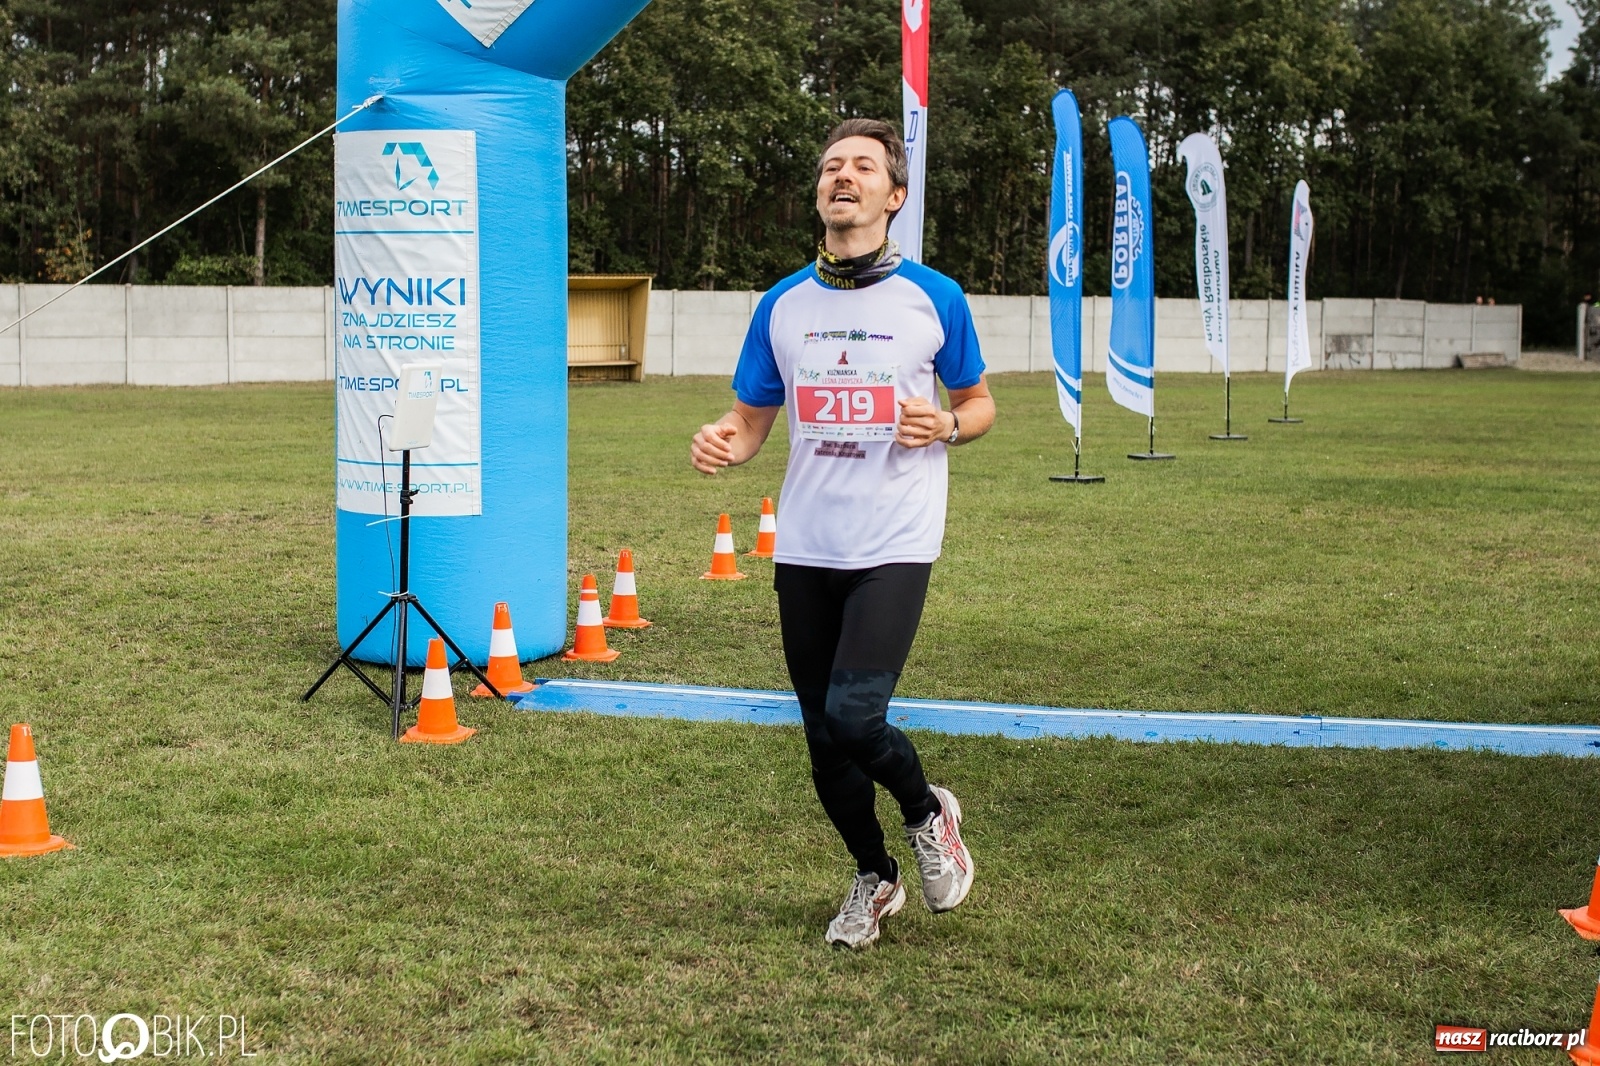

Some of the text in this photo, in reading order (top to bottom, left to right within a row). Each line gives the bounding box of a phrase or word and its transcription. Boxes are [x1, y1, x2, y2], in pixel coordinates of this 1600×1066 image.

[337, 200, 468, 216] TIMESPORT
[338, 277, 466, 306] WYNIKI
[342, 312, 457, 328] ZNAJDZIESZ
[343, 334, 455, 350] NA STRONIE
[814, 389, 875, 422] 219
